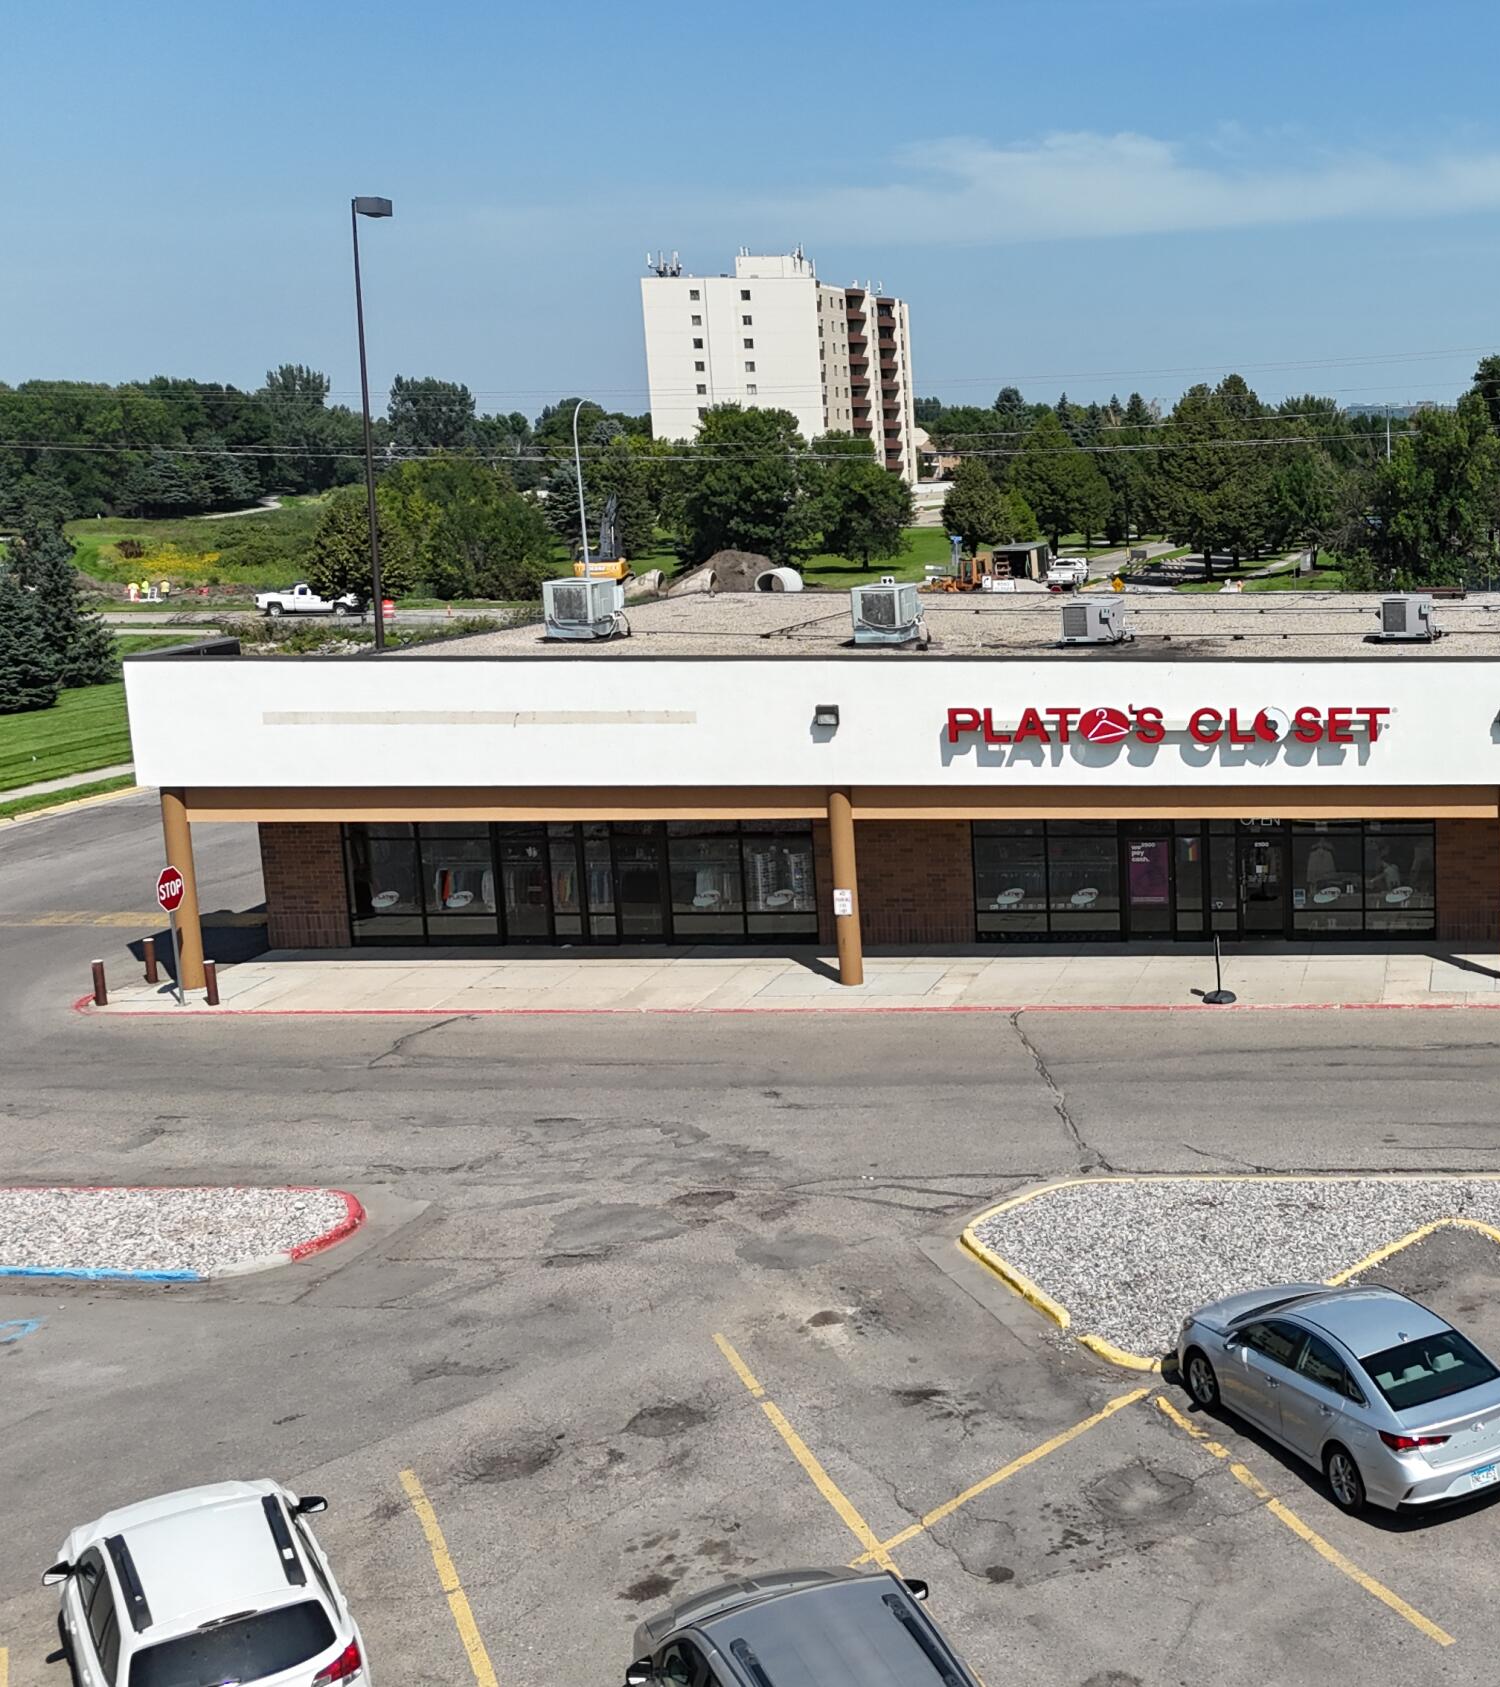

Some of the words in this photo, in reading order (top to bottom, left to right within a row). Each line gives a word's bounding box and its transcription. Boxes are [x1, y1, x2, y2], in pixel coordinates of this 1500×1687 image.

[947, 703, 1166, 745] PLATO'S
[1189, 706, 1391, 744] CLOSET
[159, 878, 182, 901] STOP
